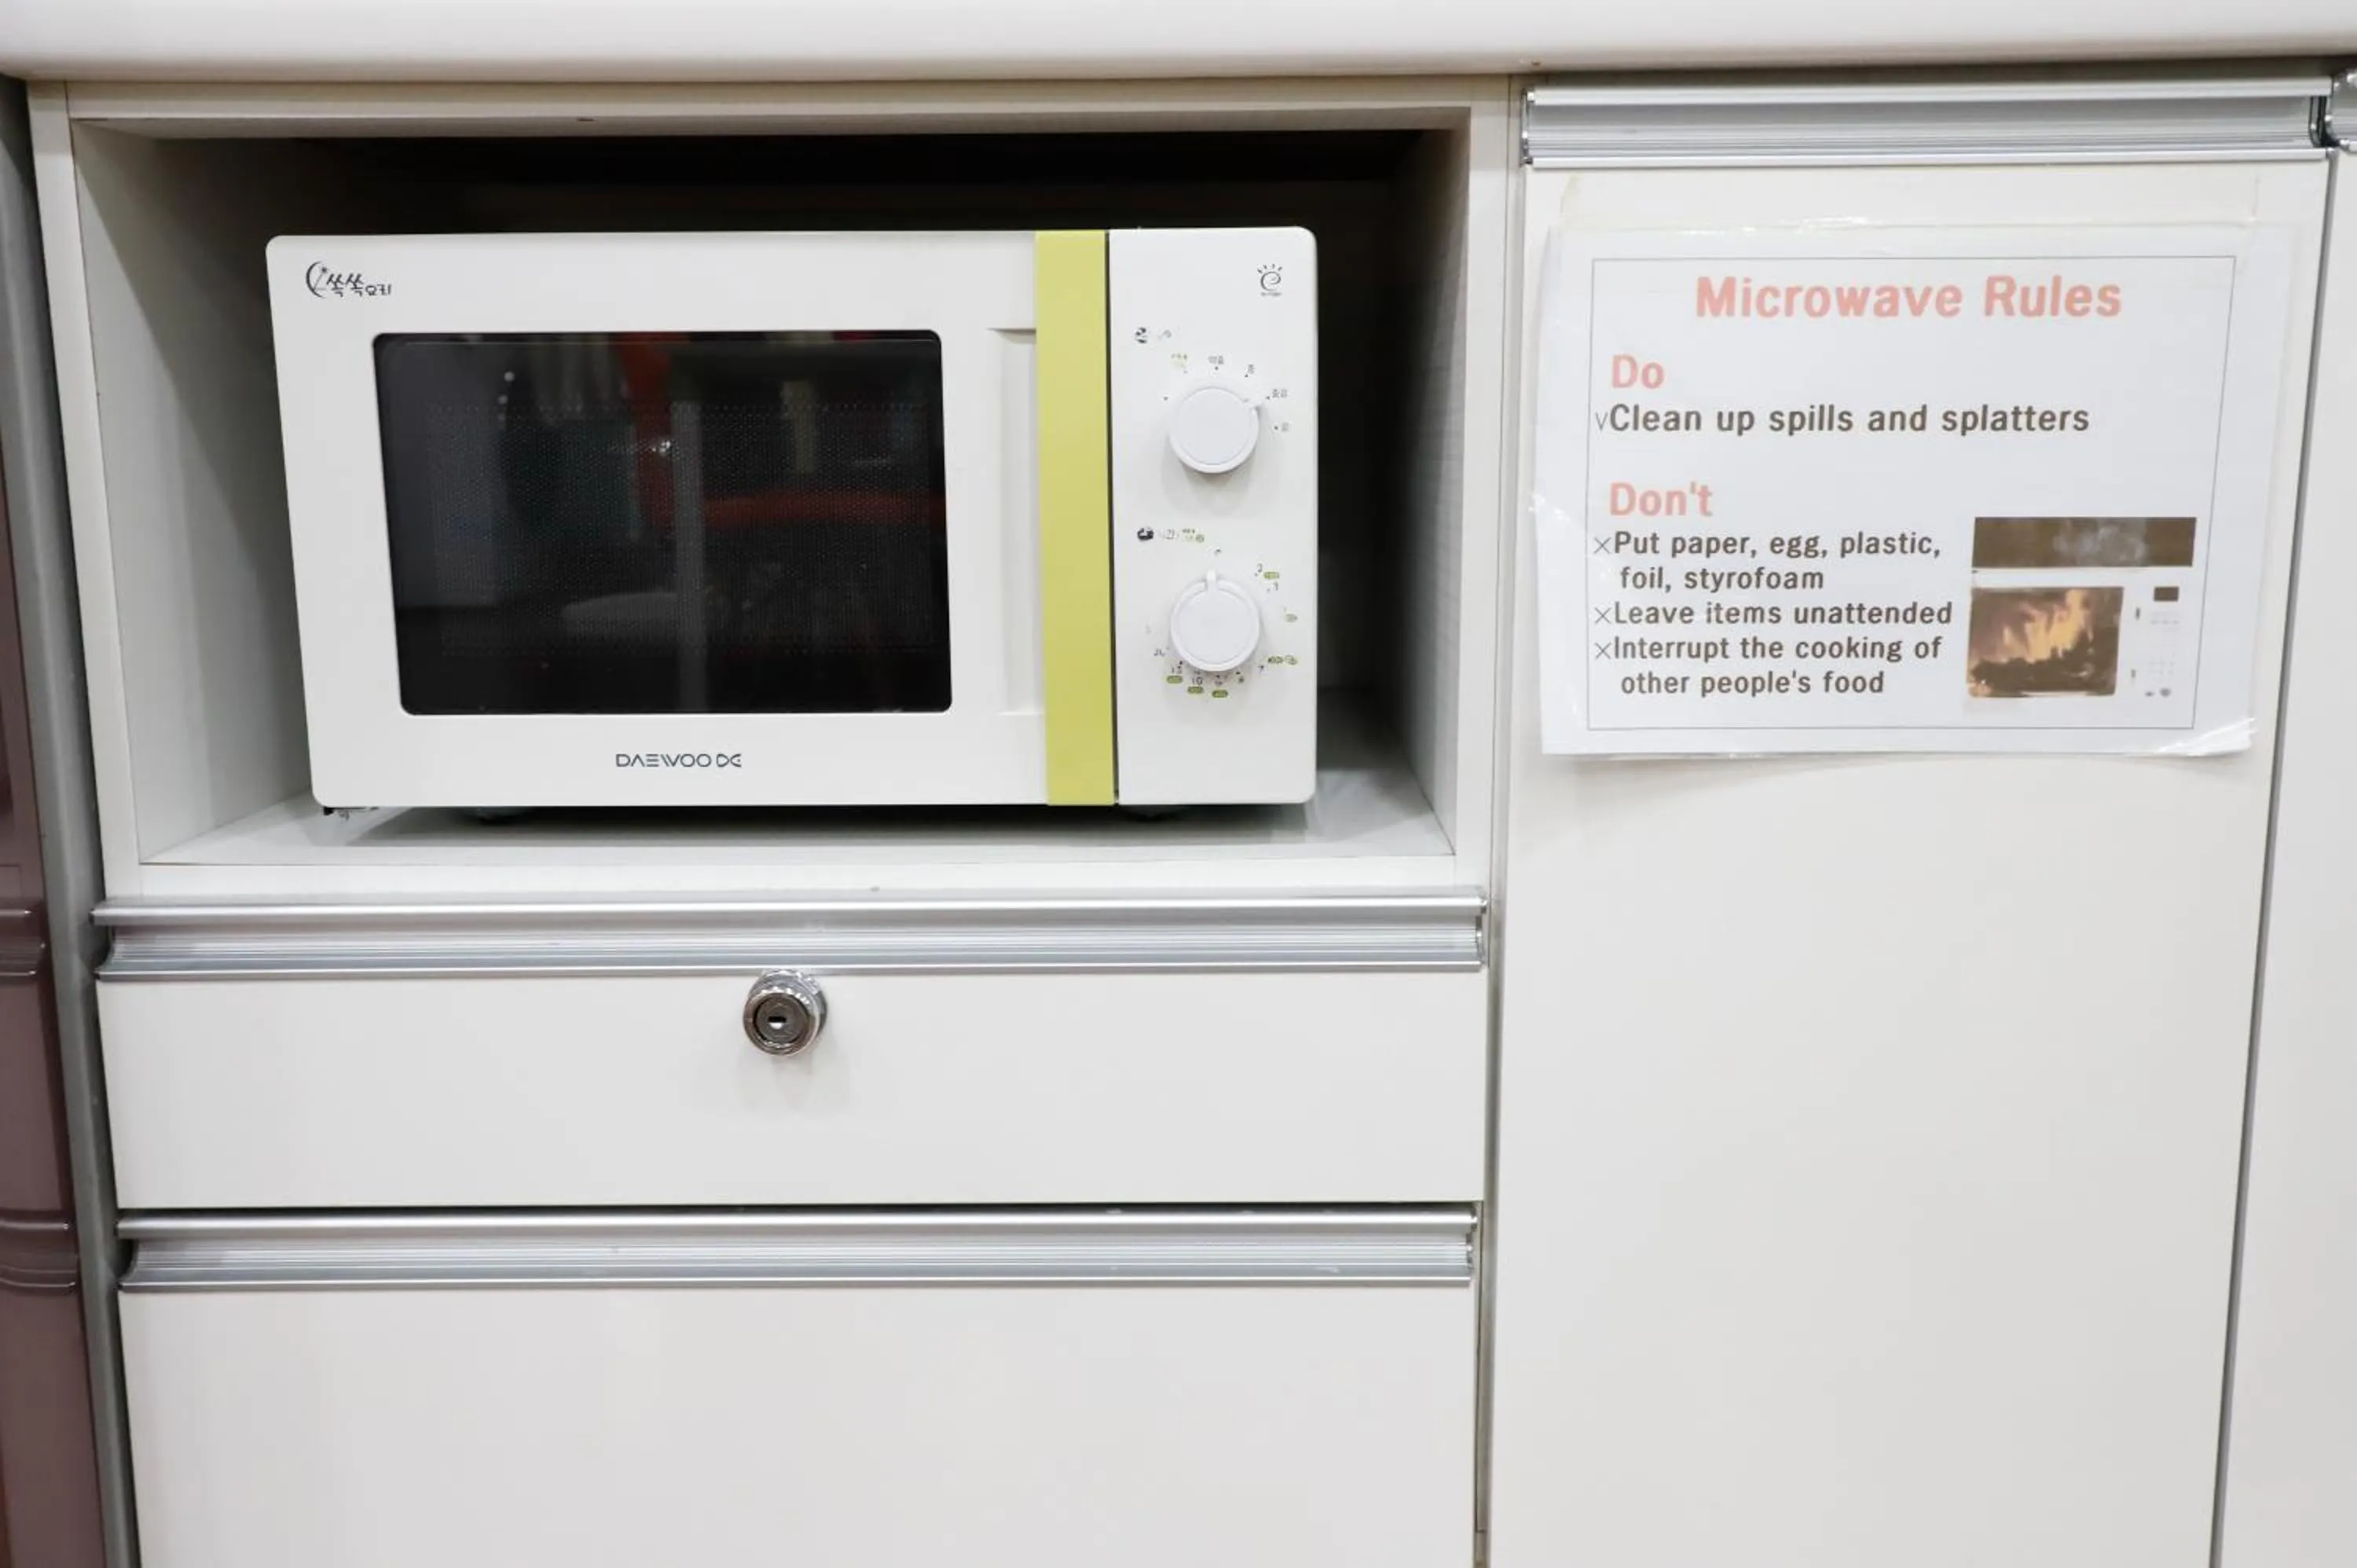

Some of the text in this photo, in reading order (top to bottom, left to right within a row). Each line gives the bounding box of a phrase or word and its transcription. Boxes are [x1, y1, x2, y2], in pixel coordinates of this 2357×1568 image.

[1695, 274, 2122, 318] Microwave Rules
[1611, 354, 1665, 390] Do
[1609, 403, 2090, 437] Clean up spills and splatters
[1609, 481, 1713, 517] Don't
[1613, 530, 1941, 559] Put paper, egg, plastic,
[1620, 566, 1824, 594] foil, styrofoam
[1613, 601, 1953, 625] Leave items unattended
[1614, 636, 1943, 664] Interrupt the cooking of
[1621, 669, 1885, 698] other people's food
[615, 753, 712, 768] DAEWOO
